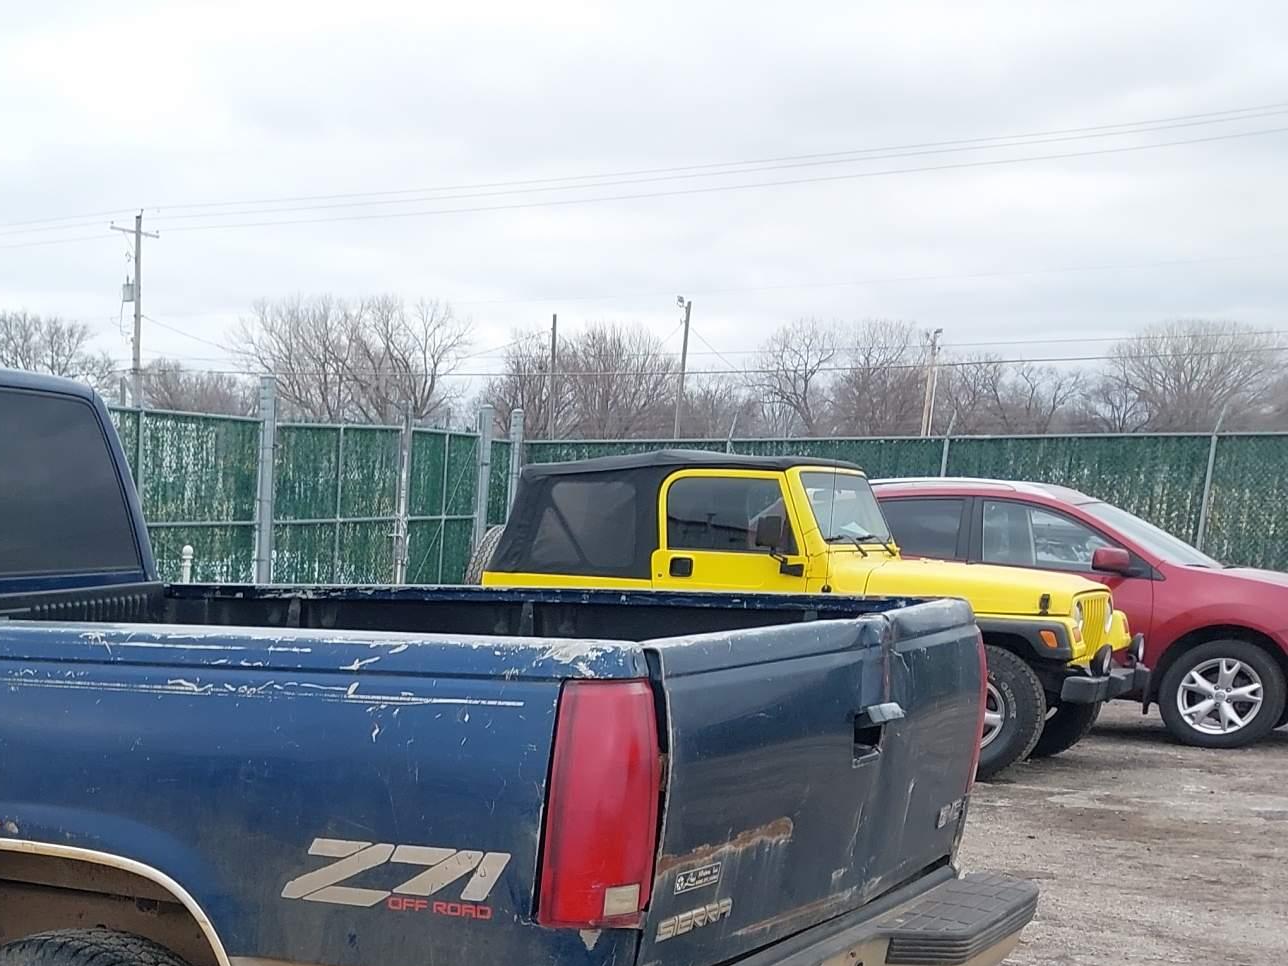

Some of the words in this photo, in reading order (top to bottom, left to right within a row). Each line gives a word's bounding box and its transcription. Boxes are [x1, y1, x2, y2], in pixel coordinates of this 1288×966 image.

[281, 837, 511, 907] Z71
[387, 896, 428, 912] OFF
[433, 901, 492, 920] ROAD
[655, 897, 732, 944] SIERRA
